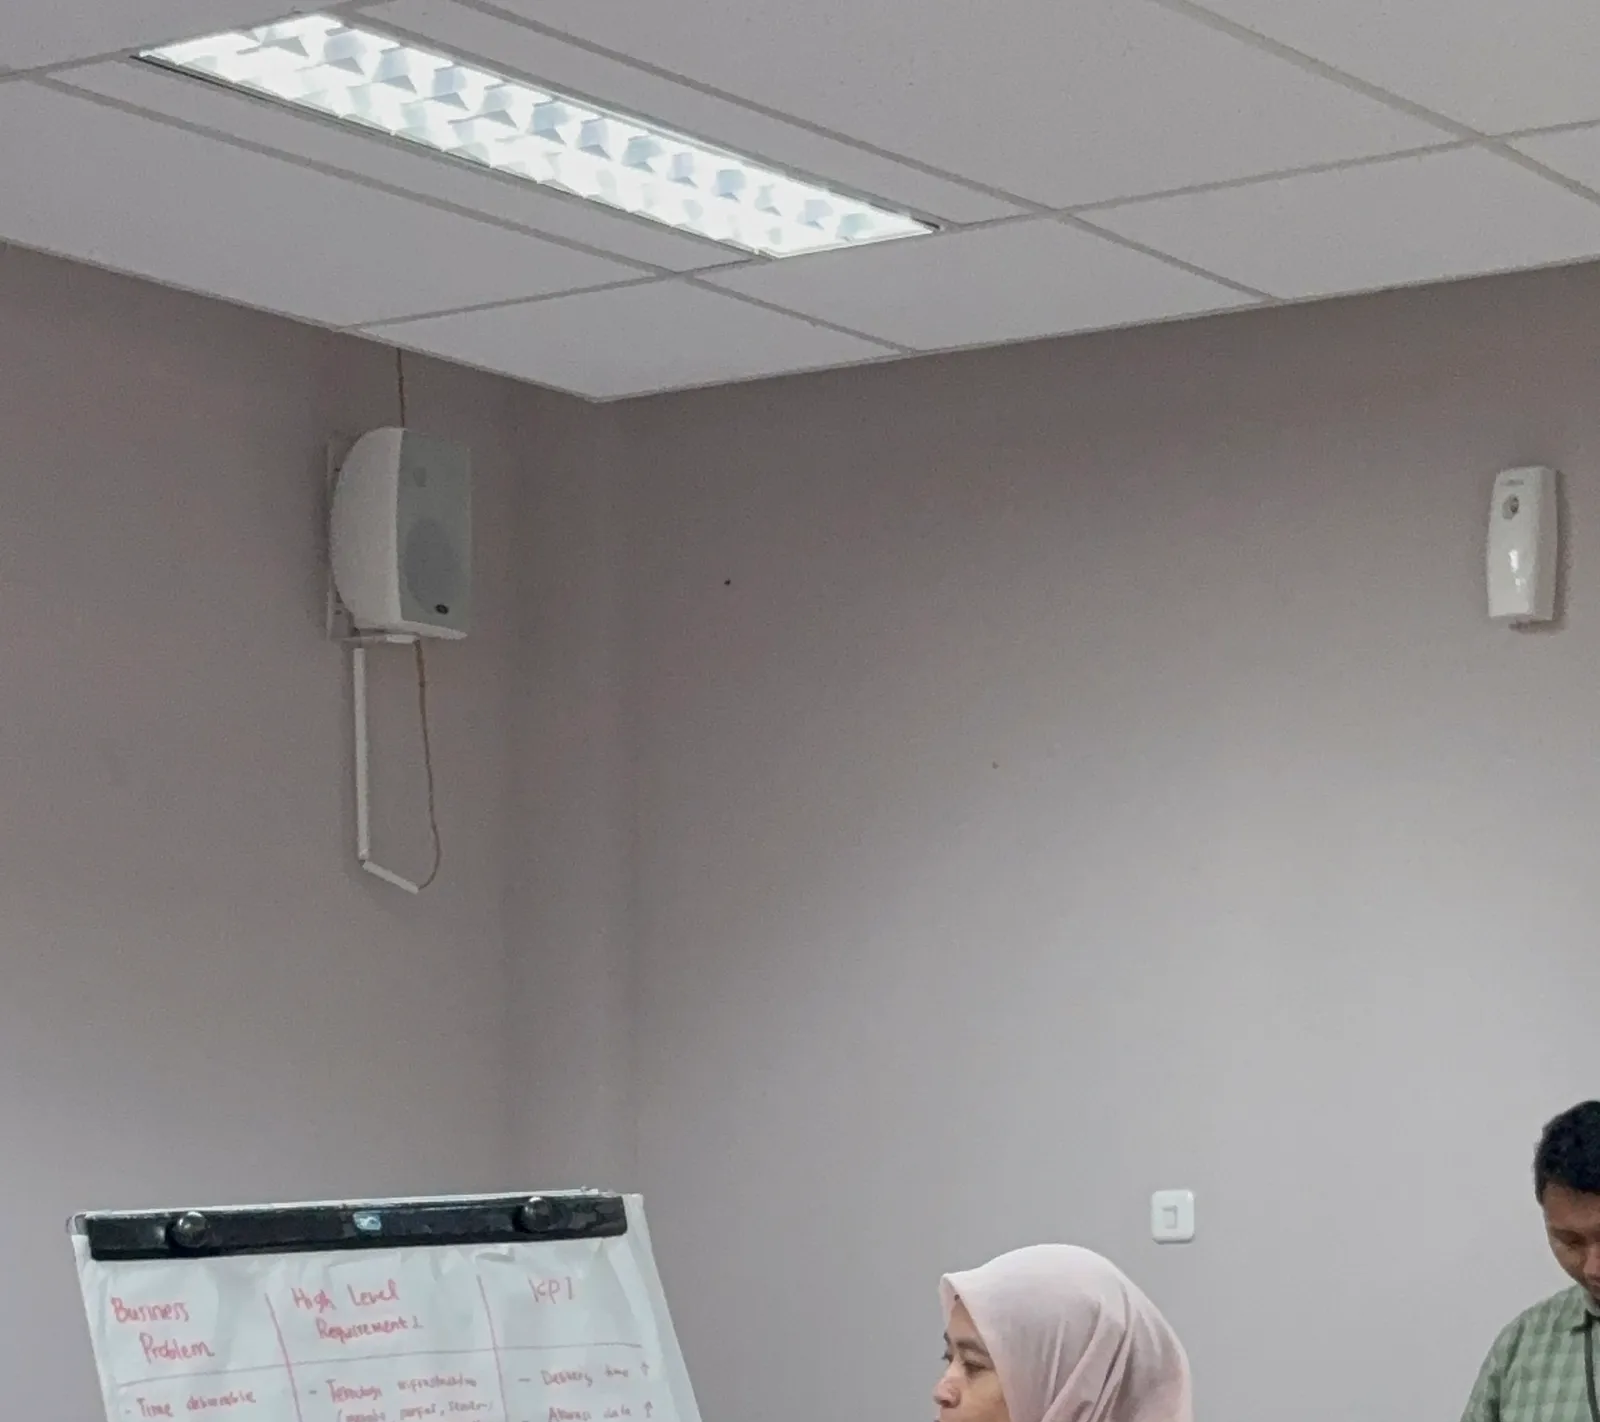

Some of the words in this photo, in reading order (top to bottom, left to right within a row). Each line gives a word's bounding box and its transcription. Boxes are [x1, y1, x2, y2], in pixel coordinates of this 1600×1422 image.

[291, 1287, 337, 1313] High
[347, 1278, 400, 1306] Level
[527, 1276, 573, 1304] KPI
[111, 1297, 190, 1323] Business
[139, 1332, 215, 1364] Problem
[136, 1397, 174, 1418] Time
